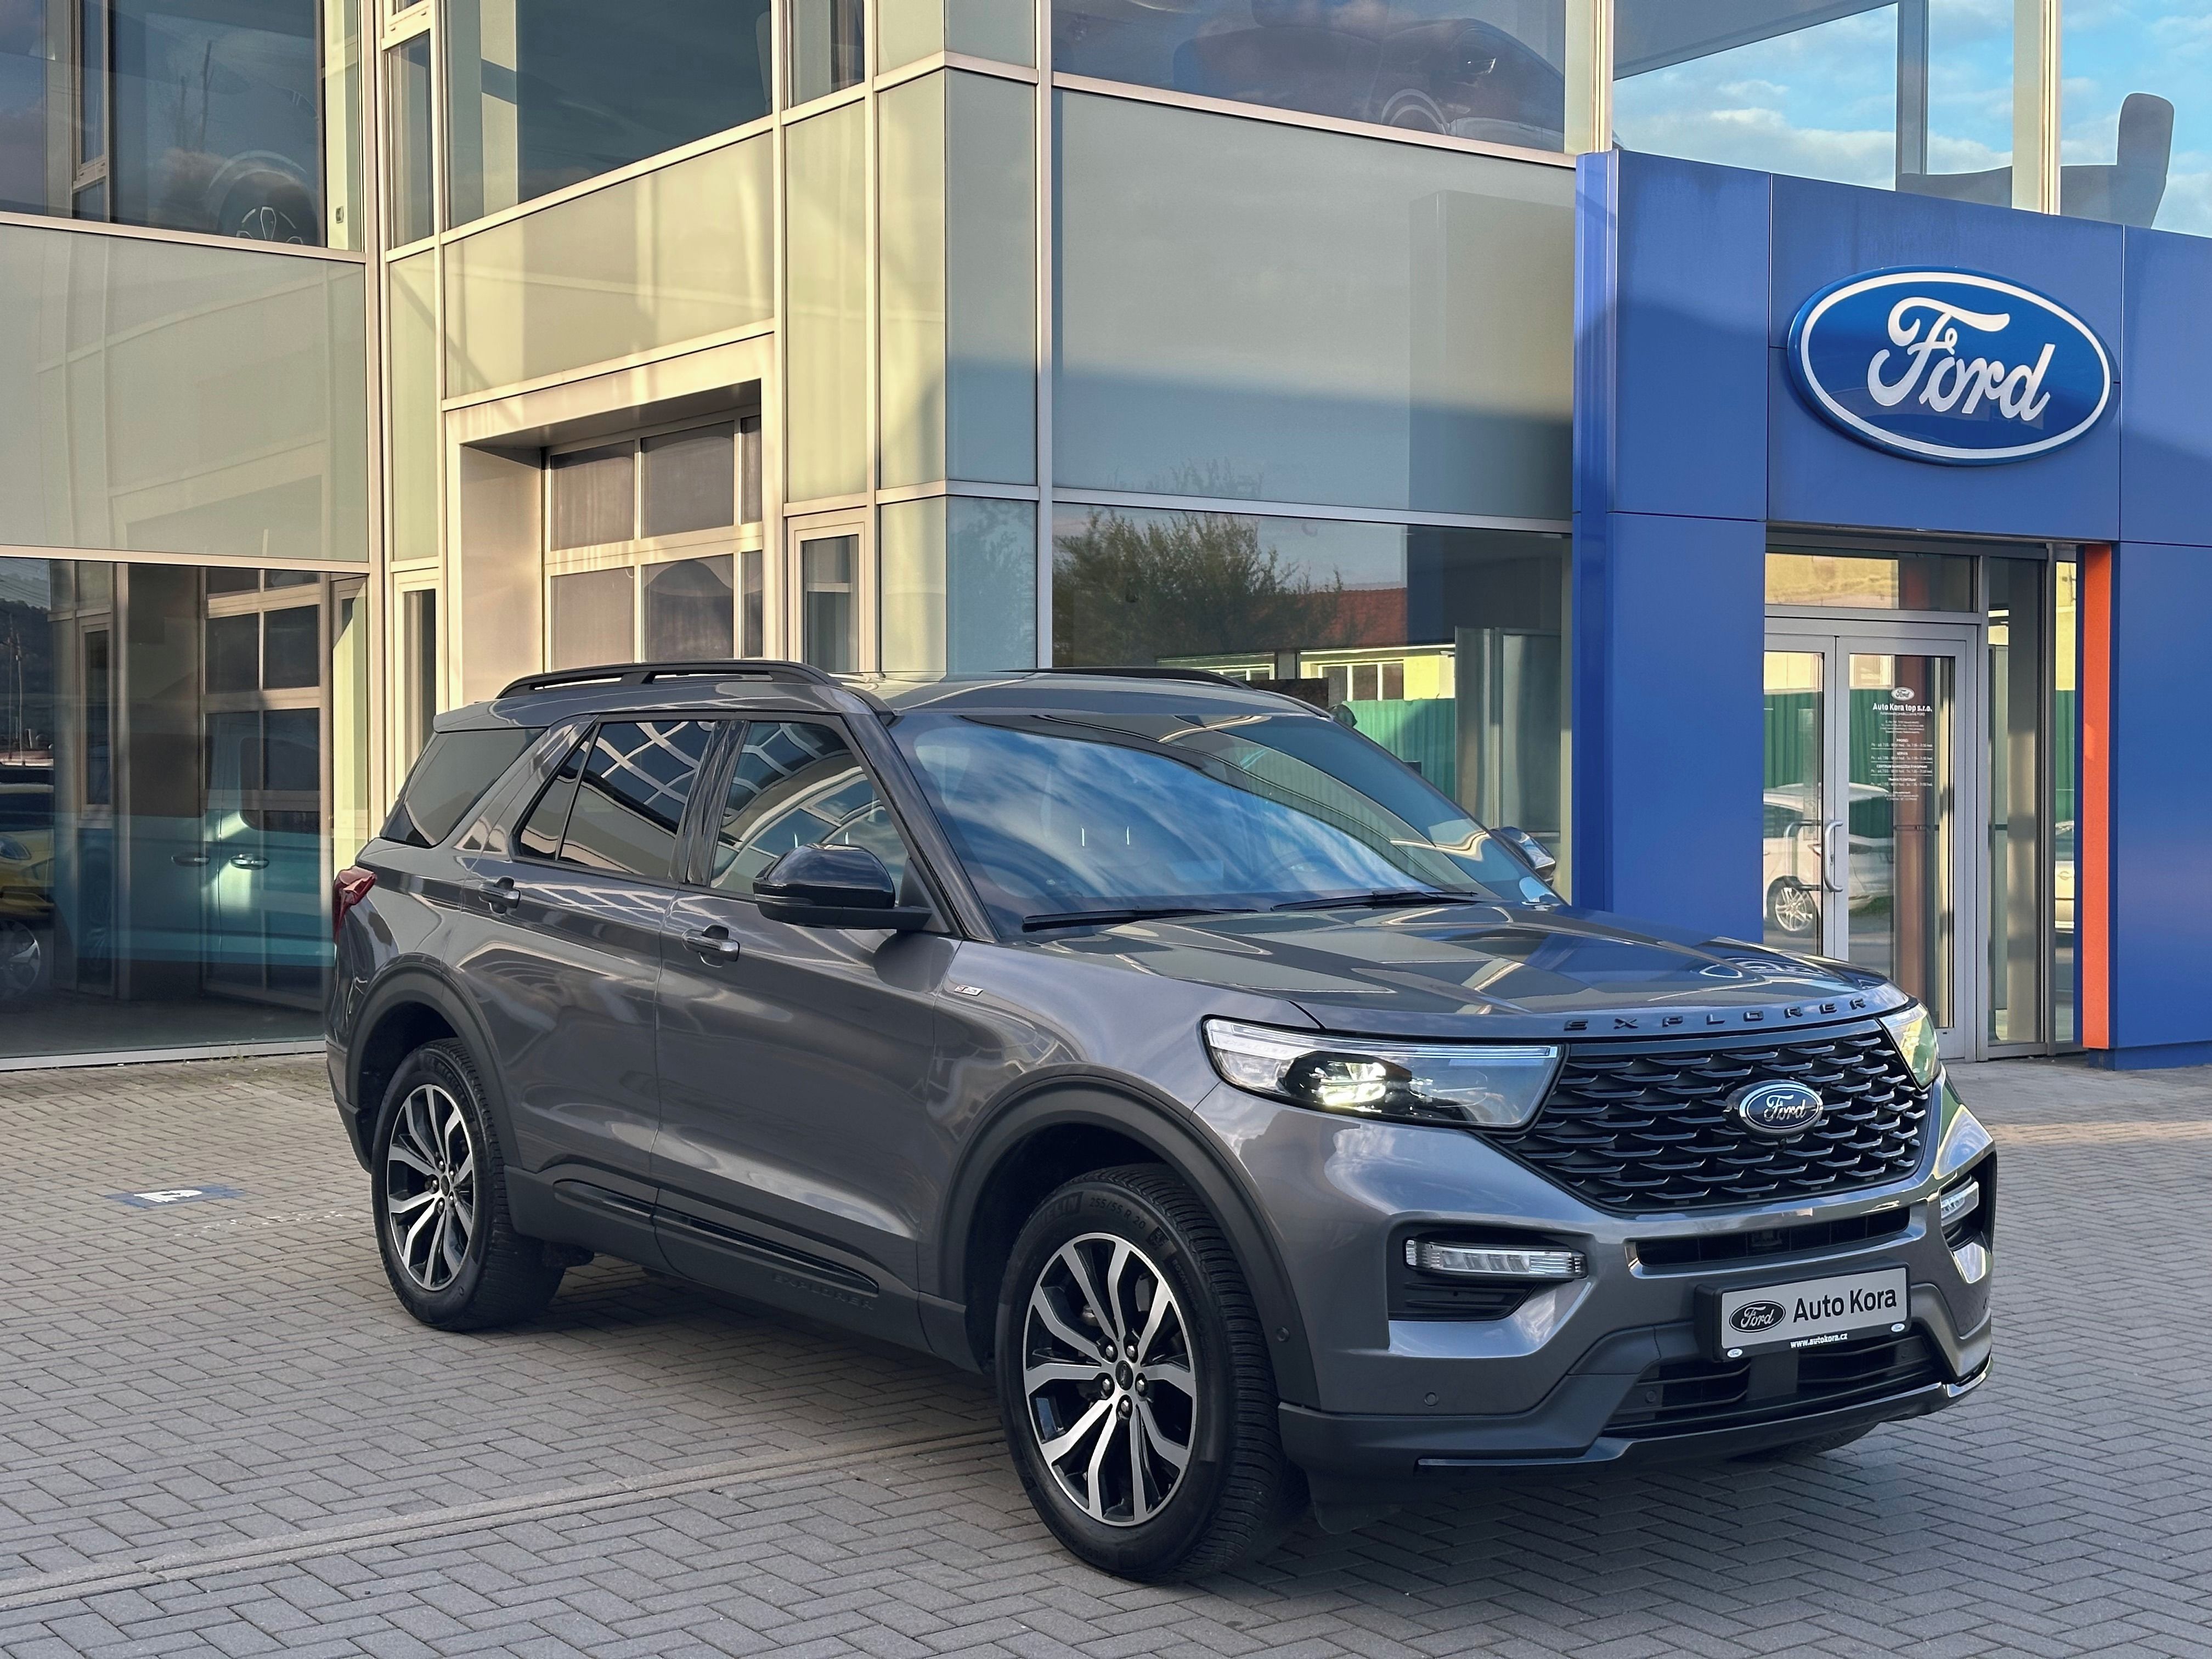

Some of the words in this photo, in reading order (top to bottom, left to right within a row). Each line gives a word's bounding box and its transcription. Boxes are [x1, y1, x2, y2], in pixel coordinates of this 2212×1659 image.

[1867, 297, 2055, 421] Ford
[1896, 690, 1910, 698] Ford
[1905, 704, 1916, 713] top
[1564, 997, 1866, 1031] EXPLORER
[1763, 1094, 1807, 1121] Ford
[1090, 1198, 1123, 1214] 255/55
[1124, 1209, 1132, 1220] R
[1132, 1216, 1146, 1229] 20
[1740, 1306, 1774, 1328] Ford
[1793, 1295, 1844, 1323] Auto
[1849, 1288, 1897, 1314] Kora
[1790, 1333, 1848, 1348] www.autokora.cz
